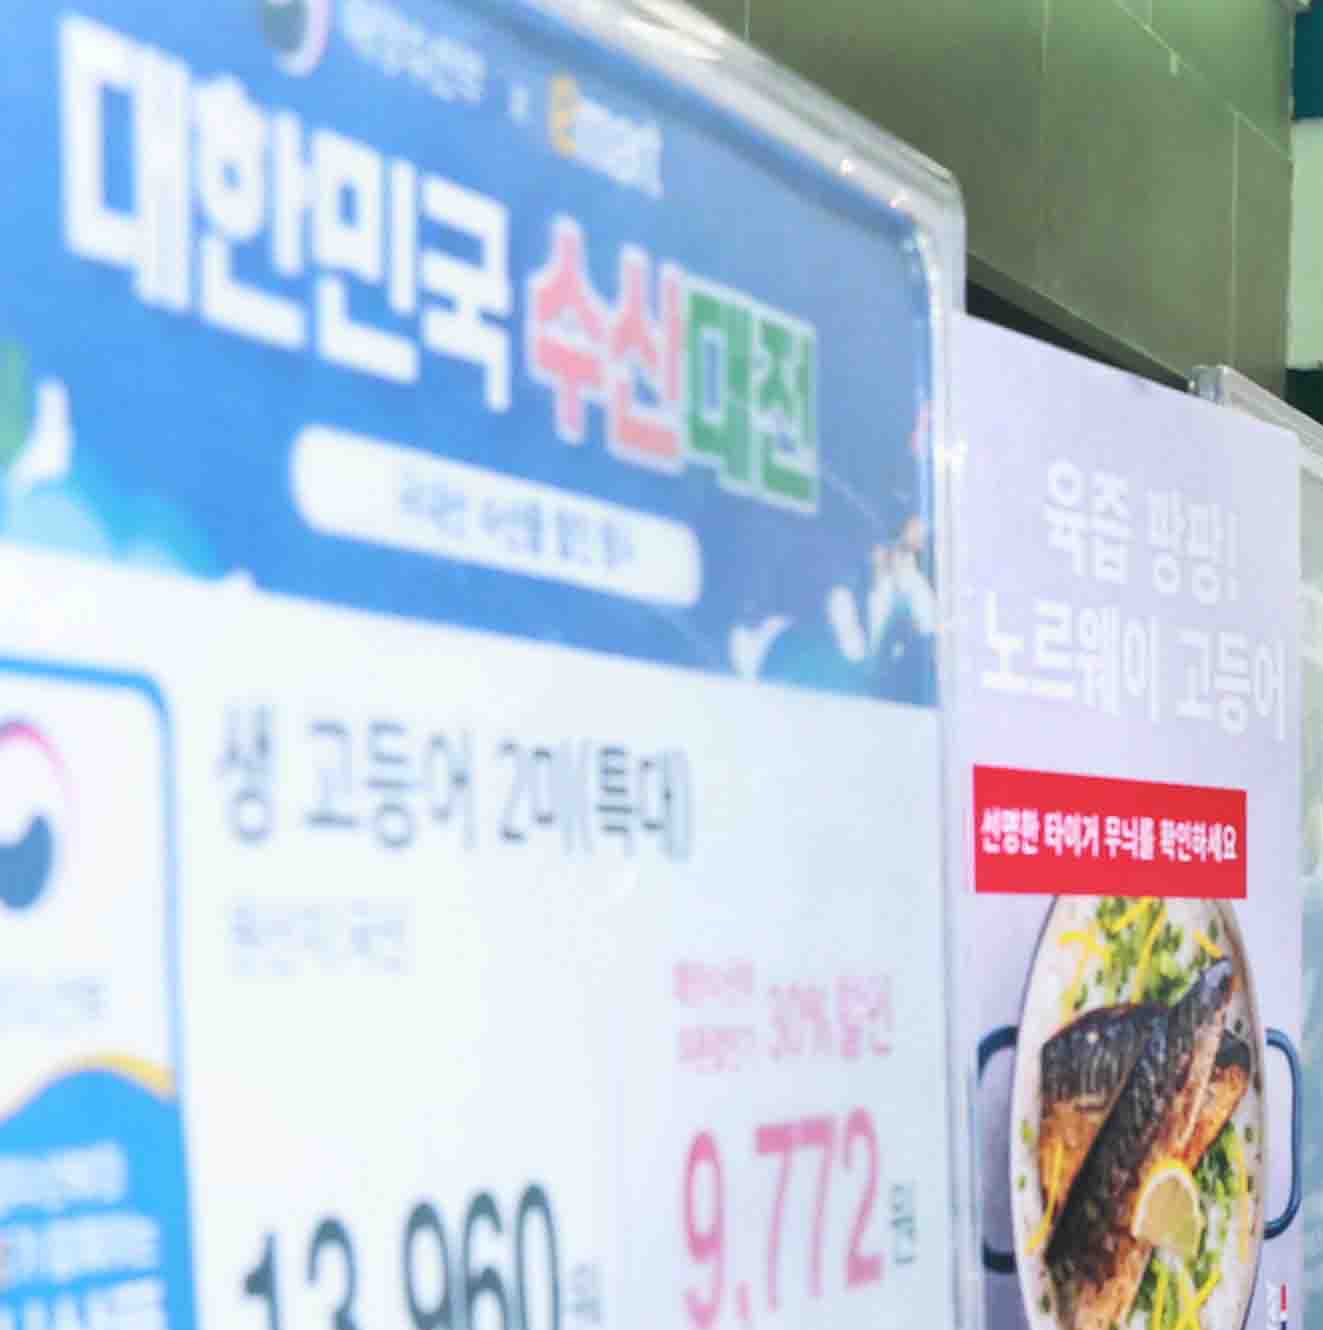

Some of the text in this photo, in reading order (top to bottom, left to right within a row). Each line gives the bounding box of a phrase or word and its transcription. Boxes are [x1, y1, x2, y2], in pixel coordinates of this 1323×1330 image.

[58, 12, 511, 410] 대한민국
[1042, 457, 1136, 585] 육즙
[981, 589, 1287, 742] 노르웨이 고등어
[217, 702, 274, 845] 생
[303, 717, 477, 853] 고등어
[980, 807, 1238, 863] 선명한 타이거 무늬를 확인하세요
